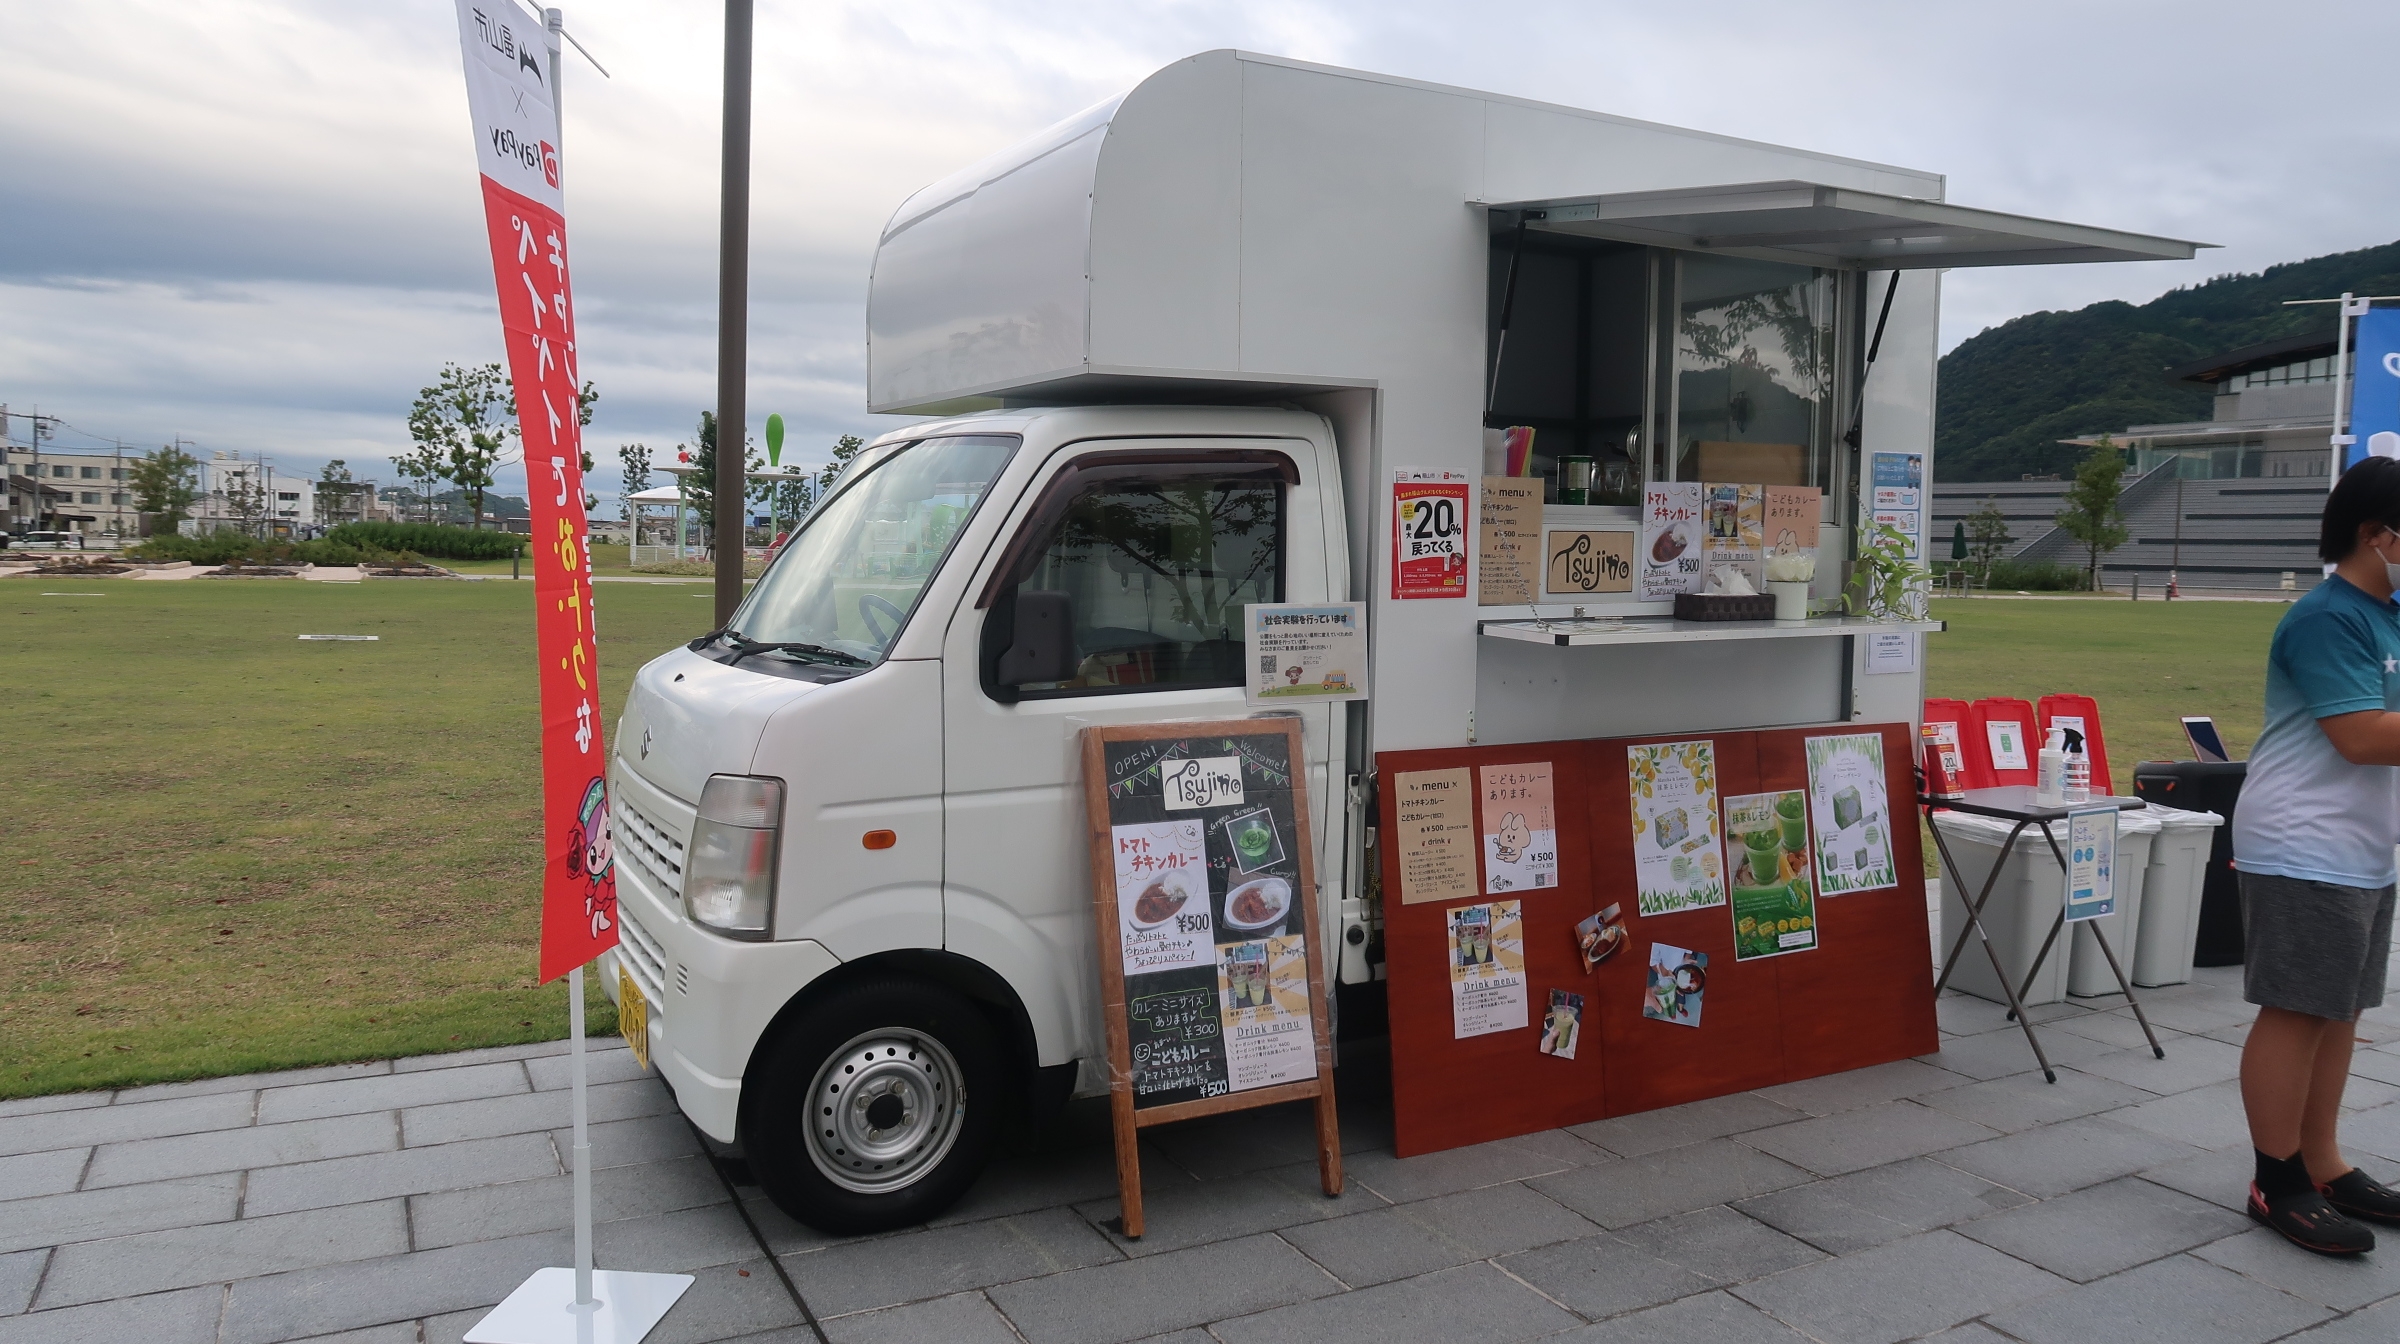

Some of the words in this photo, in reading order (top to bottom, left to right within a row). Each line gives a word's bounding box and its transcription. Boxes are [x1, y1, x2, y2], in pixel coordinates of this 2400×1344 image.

[1648, 492, 1668, 505] トマト
[1772, 493, 1817, 504] こどもカレー
[1654, 507, 1697, 521] チキンカレー
[1770, 508, 1804, 518] あります。
[1412, 540, 1453, 556] 戻ってくる
[1712, 552, 1732, 560] Drink
[1677, 557, 1700, 573] ¥500
[1264, 614, 1348, 625] 社会実験を行っています
[1115, 745, 1157, 775] OPEN!
[1240, 740, 1287, 771] Welcome!
[1422, 781, 1449, 791] menu
[1489, 774, 1547, 785] こどもカレー
[1490, 788, 1532, 800] あります。
[1402, 798, 1444, 808] トマトチキンカレー
[1733, 811, 1770, 824] 抹茶&レモン
[1120, 838, 1150, 854] トマト
[1131, 852, 1198, 871] チキンカレー
[1531, 851, 1553, 862] ¥500
[1176, 913, 1209, 933] ¥500
[1464, 979, 1489, 991] Drink
[1494, 977, 1517, 986] menu
[1185, 1023, 1216, 1039] ¥300
[1237, 1024, 1267, 1037] Drink
[1272, 1020, 1299, 1032] menu
[1152, 1045, 1210, 1066] こどもカレー
[1200, 1080, 1228, 1098] ¥500
